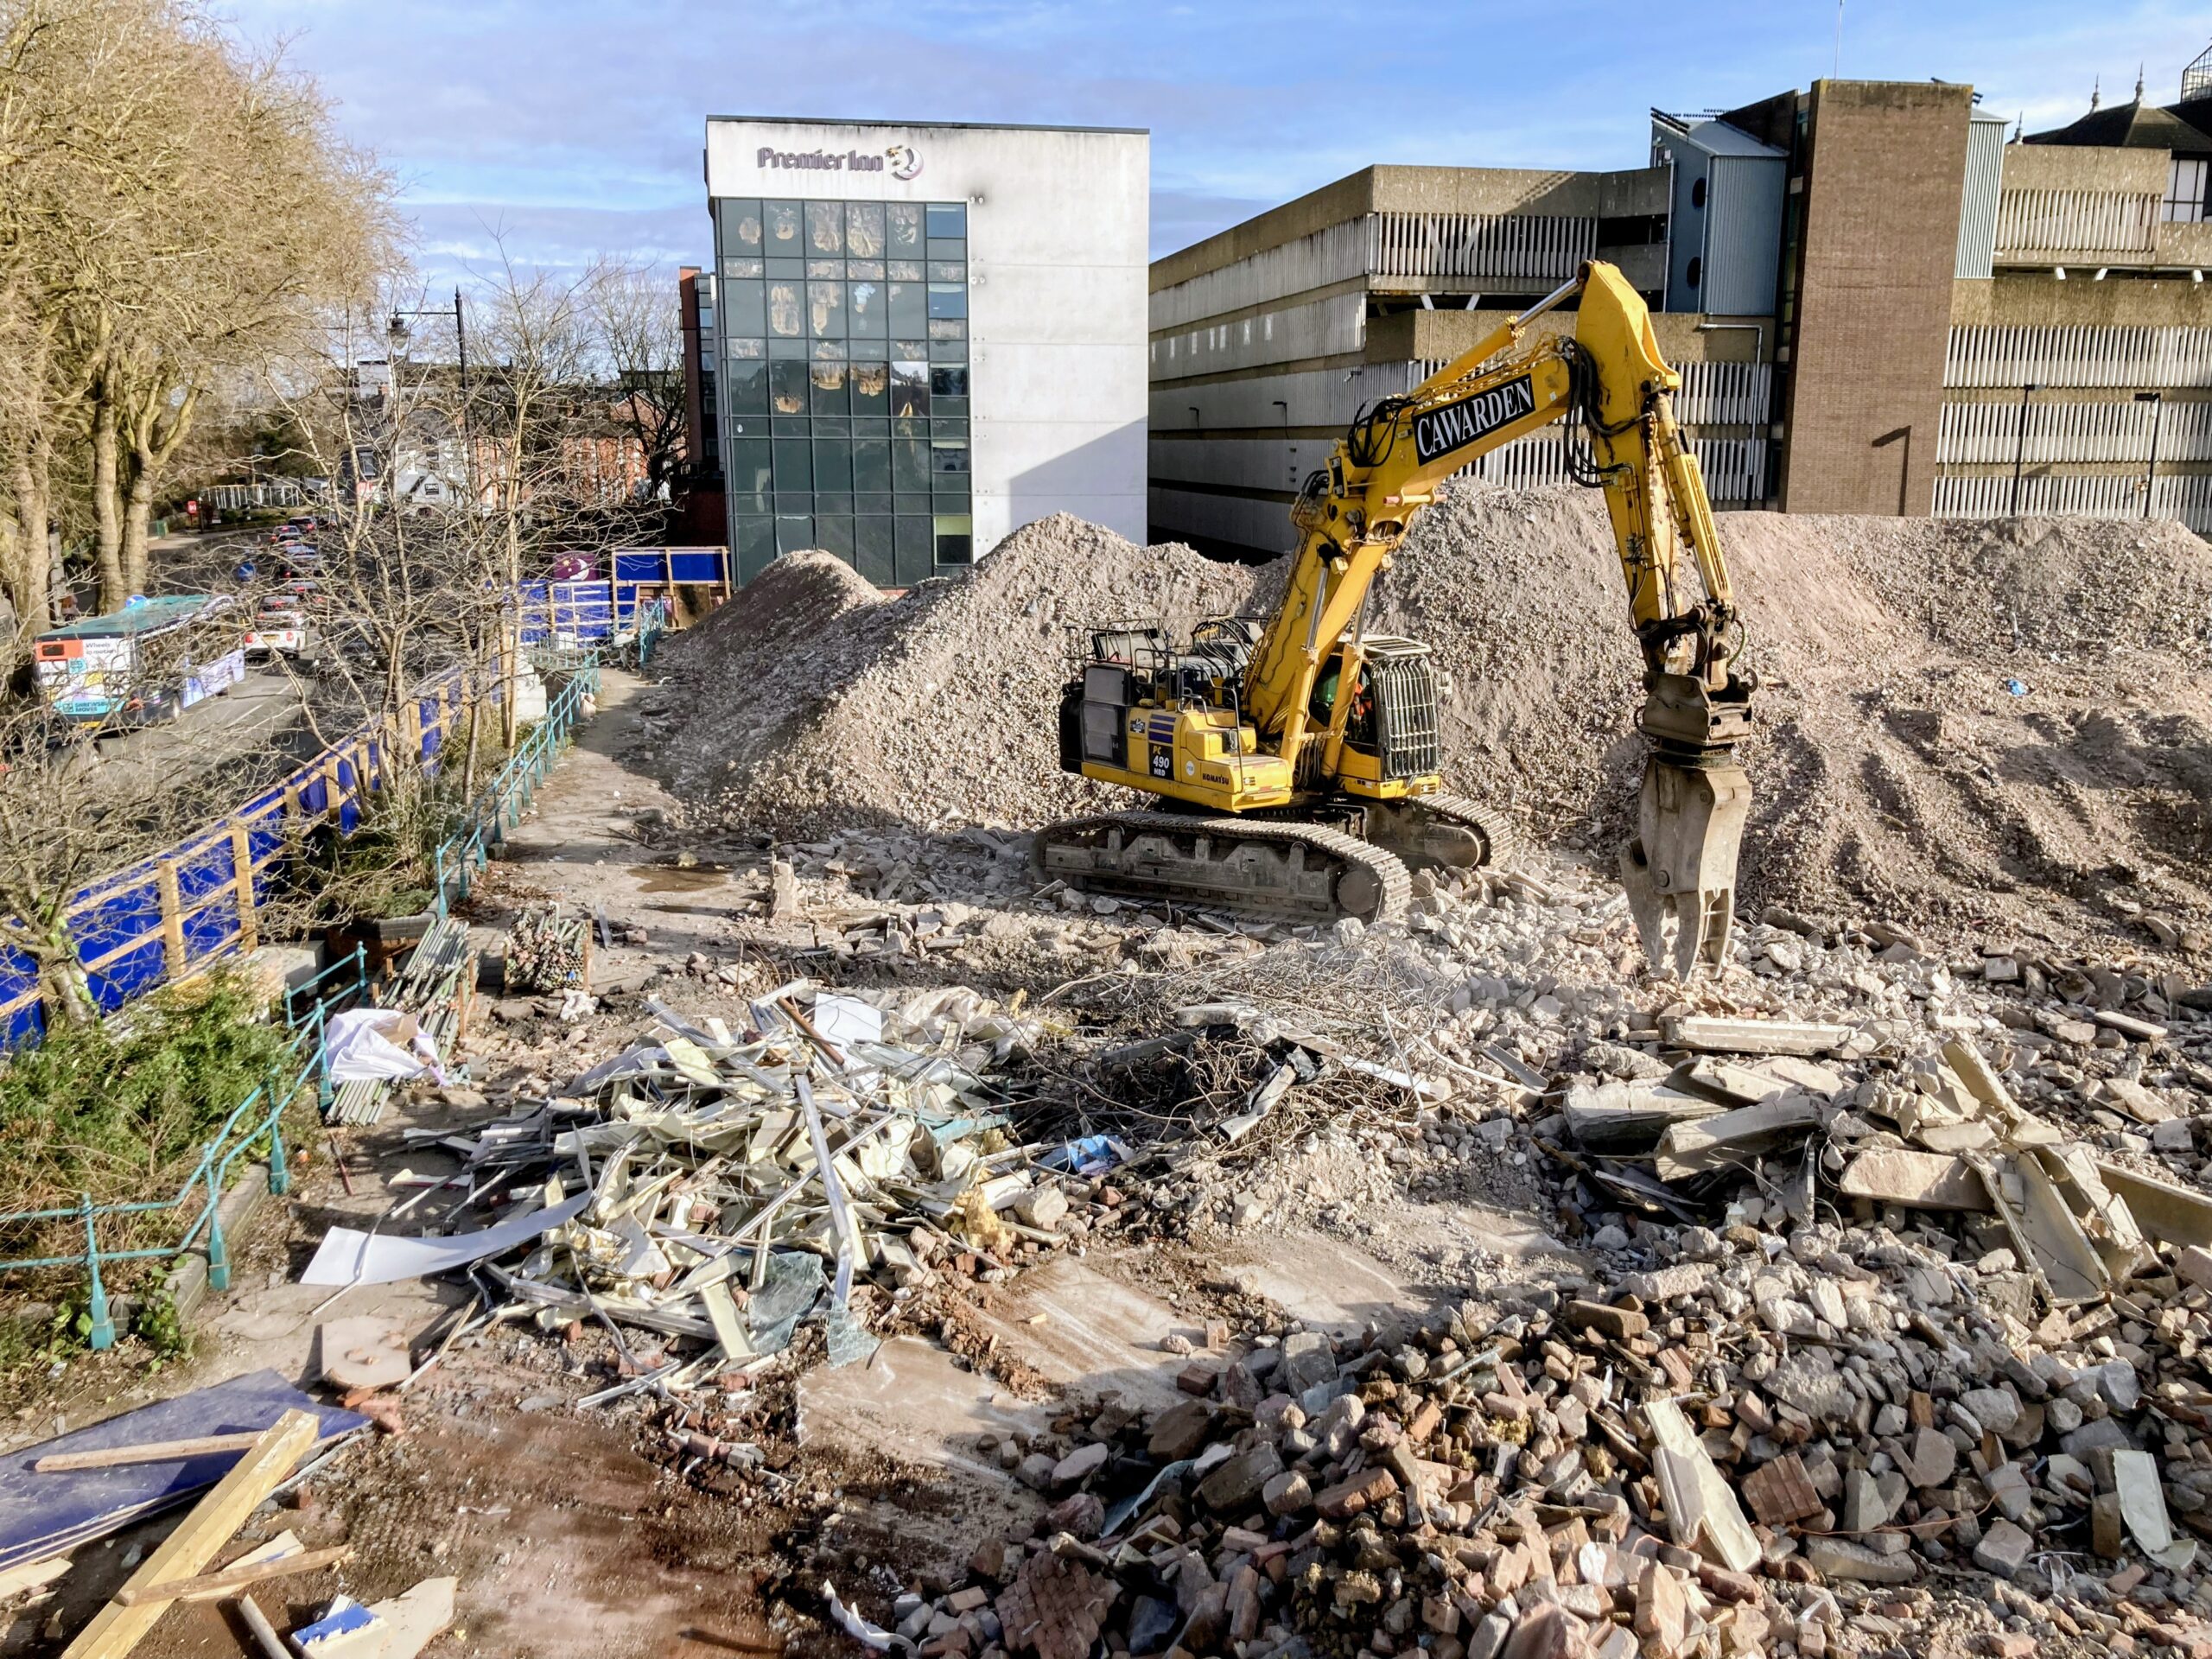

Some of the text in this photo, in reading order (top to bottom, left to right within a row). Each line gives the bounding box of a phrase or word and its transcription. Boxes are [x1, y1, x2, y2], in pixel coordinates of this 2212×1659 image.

[757, 147, 883, 171] Premier Inn
[1418, 378, 1533, 457] CAWARDEN
[1153, 745, 1162, 755] PC
[1153, 755, 1170, 769] 490
[1202, 772, 1230, 785] KOMATSU
